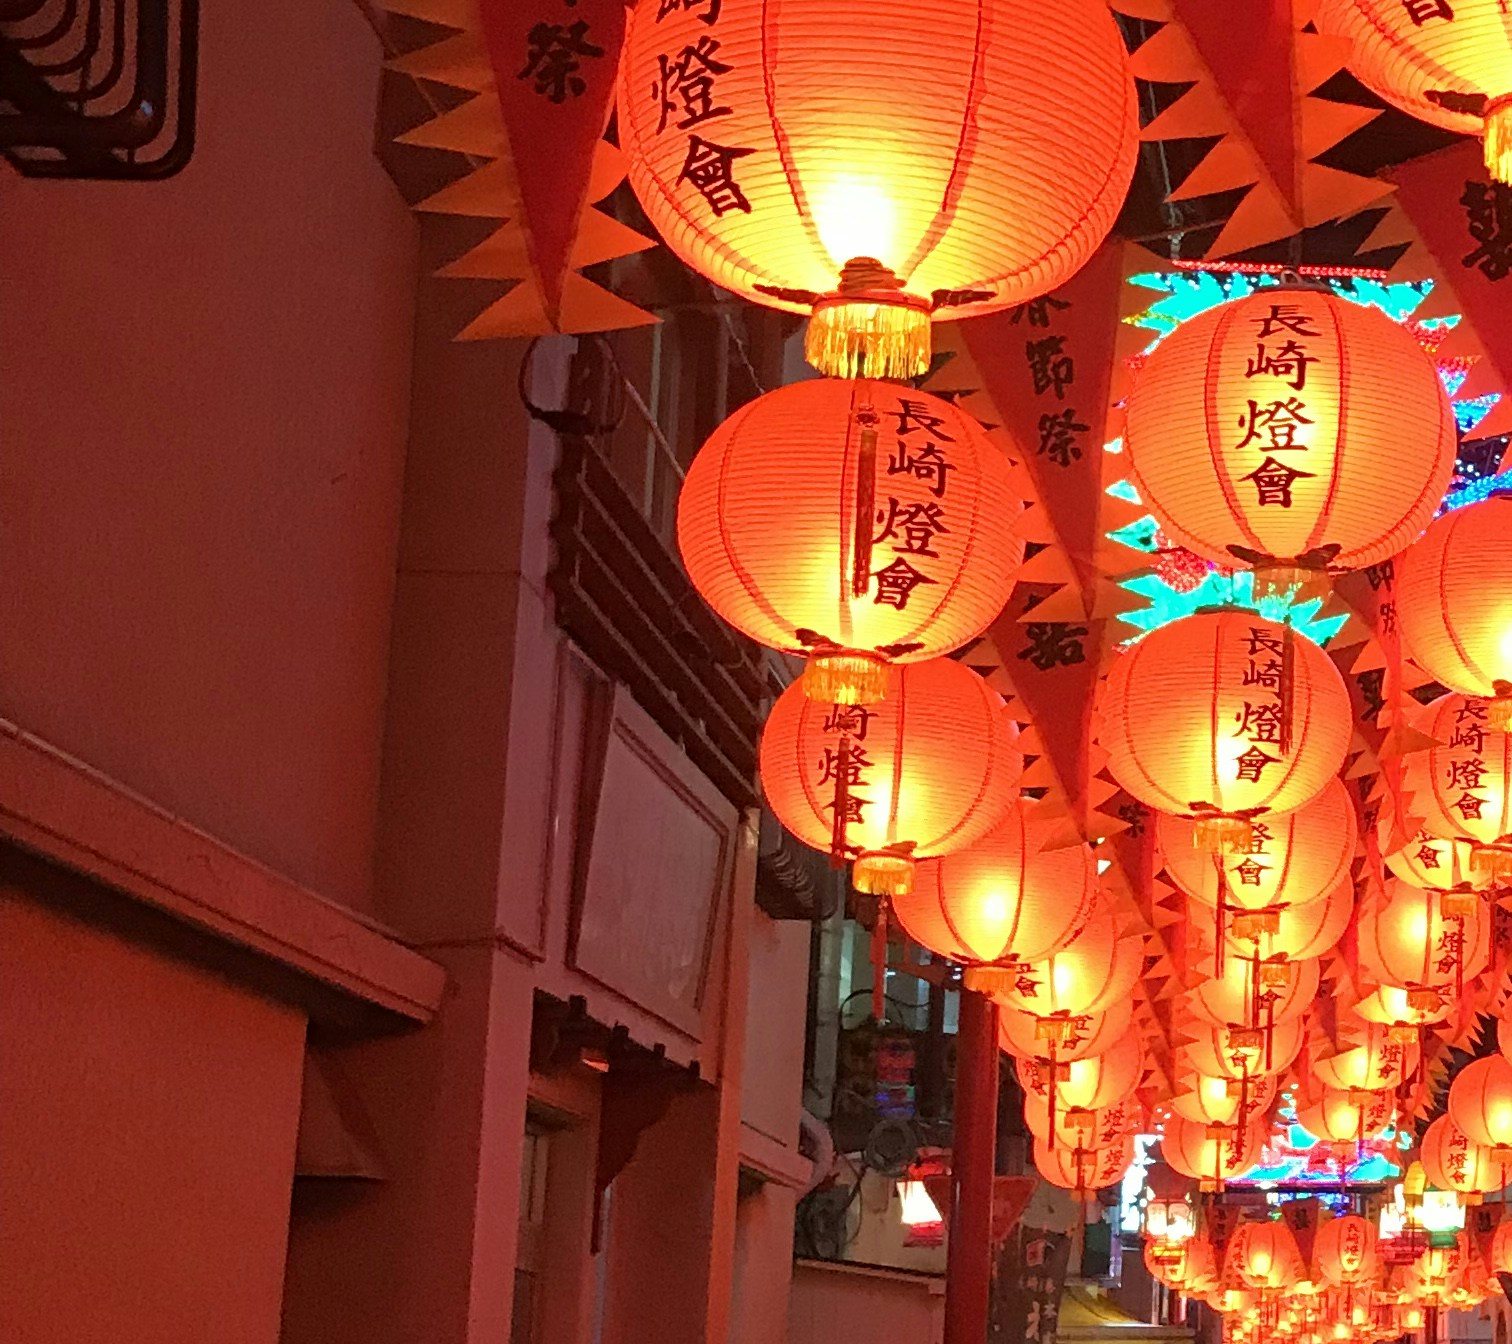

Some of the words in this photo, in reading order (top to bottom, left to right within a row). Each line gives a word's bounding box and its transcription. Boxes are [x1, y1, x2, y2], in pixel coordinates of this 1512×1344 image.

[1235, 304, 1323, 509] 長崎燈會
[871, 397, 957, 612] 長崎燈會
[1232, 626, 1285, 784] 長崎燈會
[1446, 699, 1491, 821] 長崎燈會
